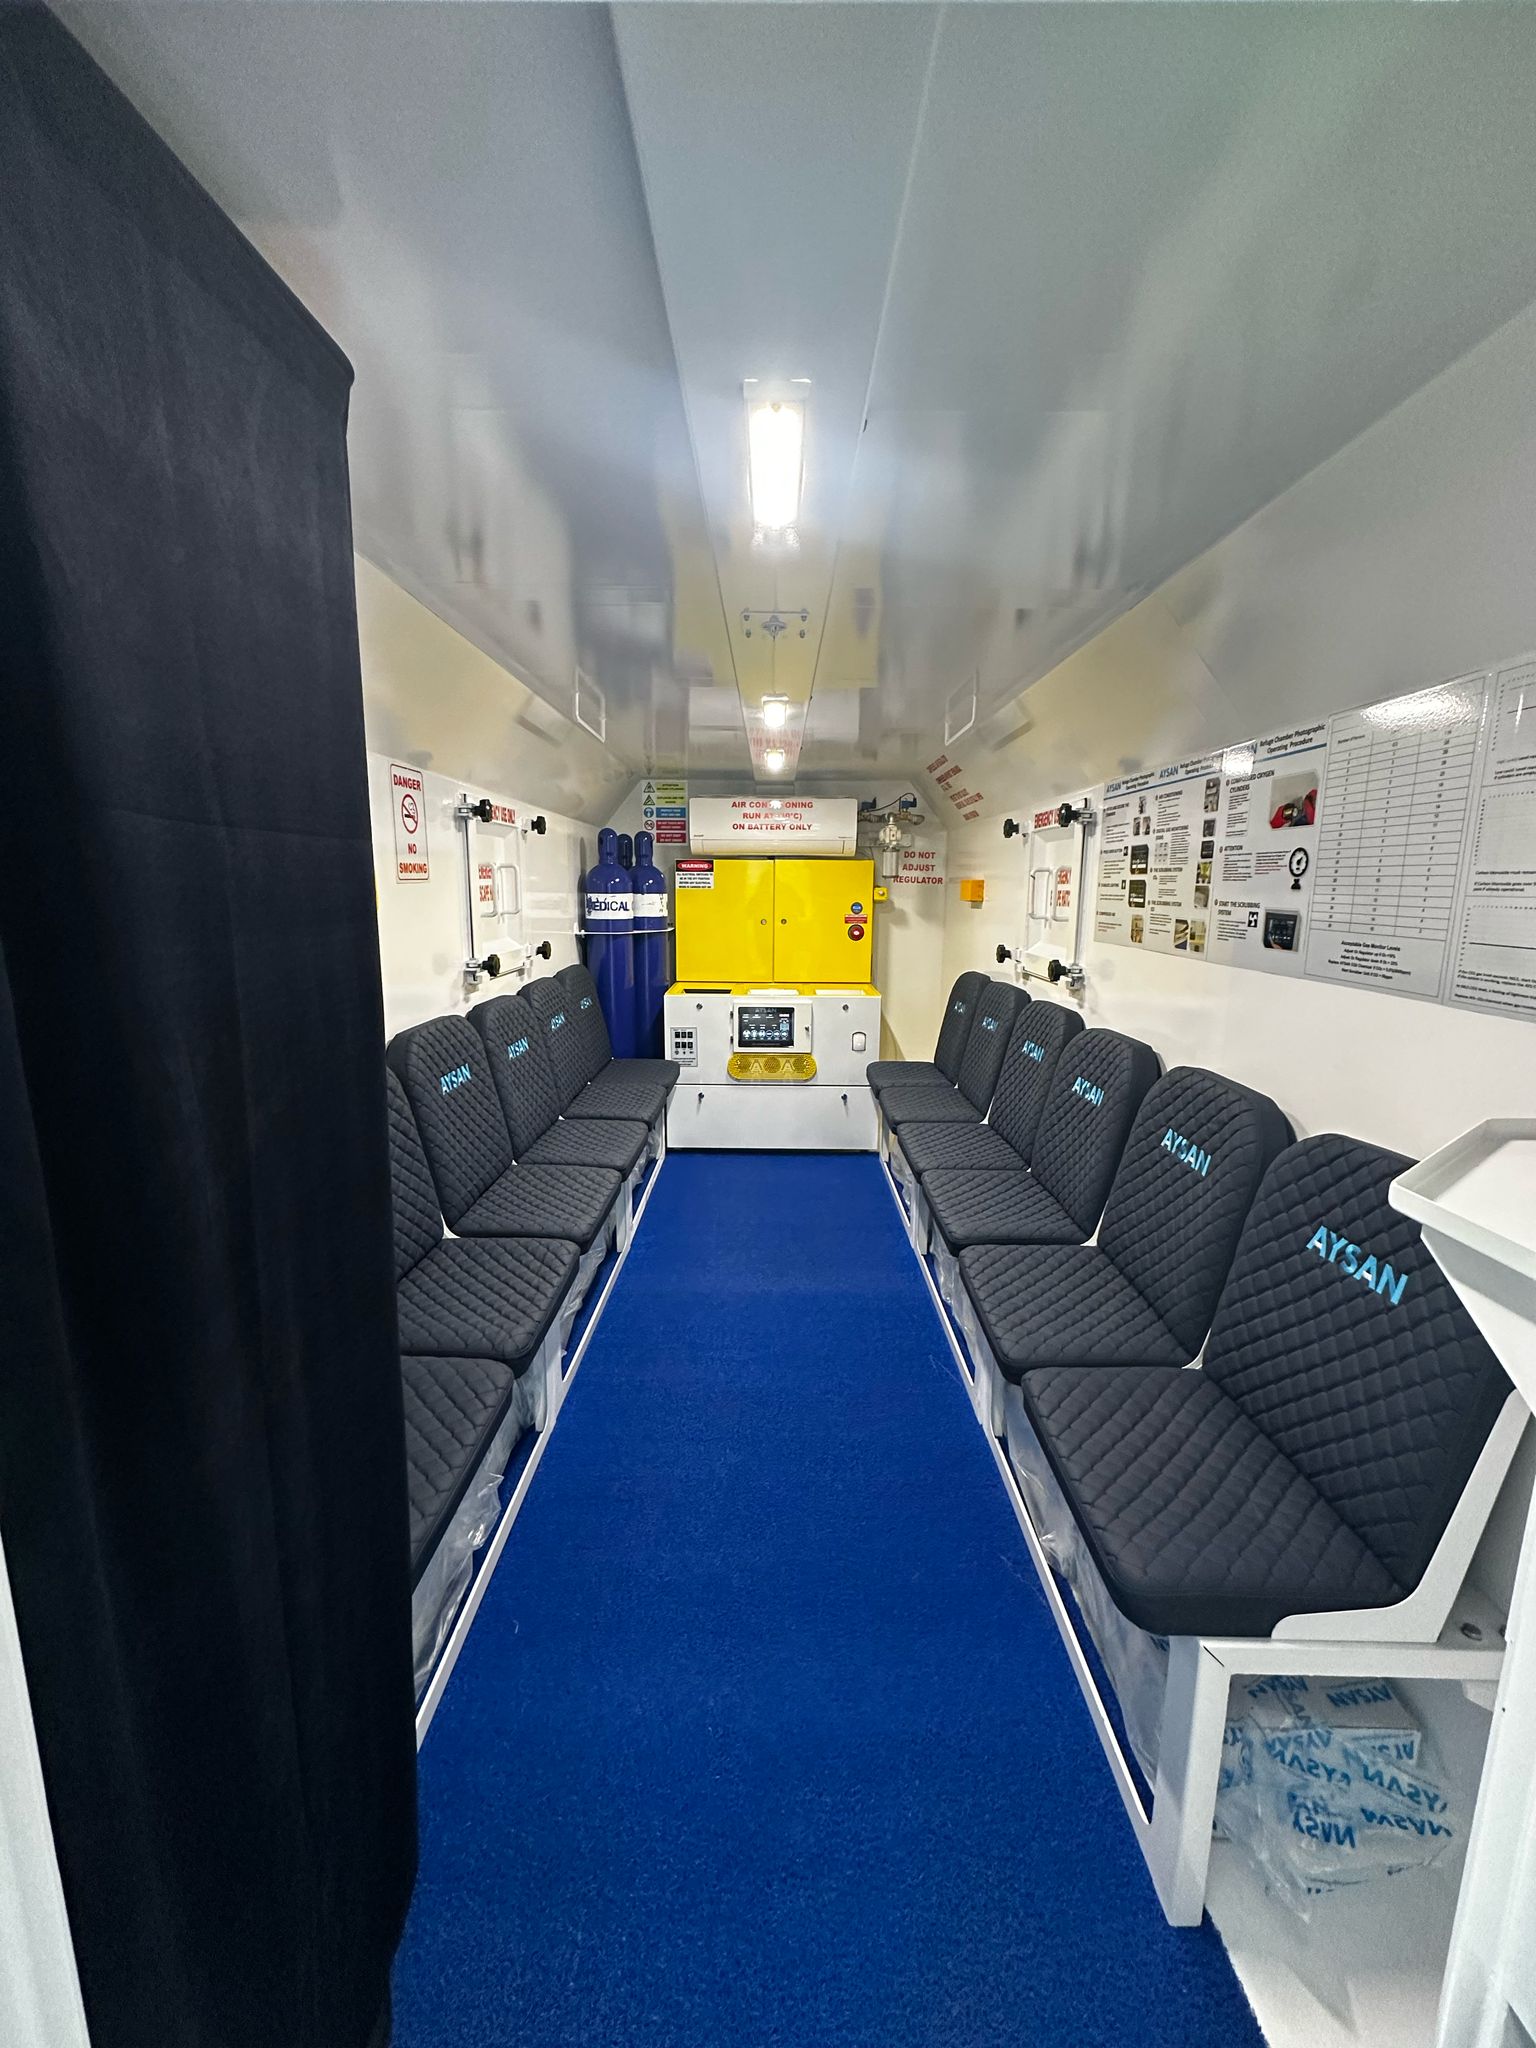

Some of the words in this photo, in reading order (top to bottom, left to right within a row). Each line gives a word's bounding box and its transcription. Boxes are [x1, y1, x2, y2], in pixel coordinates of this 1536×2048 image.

[1159, 766, 1179, 779] AYSAN
[393, 774, 421, 791] DANGER
[408, 843, 417, 854] NO
[904, 851, 915, 859] DO
[918, 851, 936, 859] NOT
[399, 863, 427, 874] SMOKING
[902, 864, 936, 872] ADJUST
[507, 1037, 530, 1060] AYSAN
[440, 1063, 472, 1096] AYSAN
[1071, 1076, 1105, 1107] AYSAN
[1160, 1128, 1212, 1177] AYSAN
[1306, 1225, 1408, 1306] AYSAN
